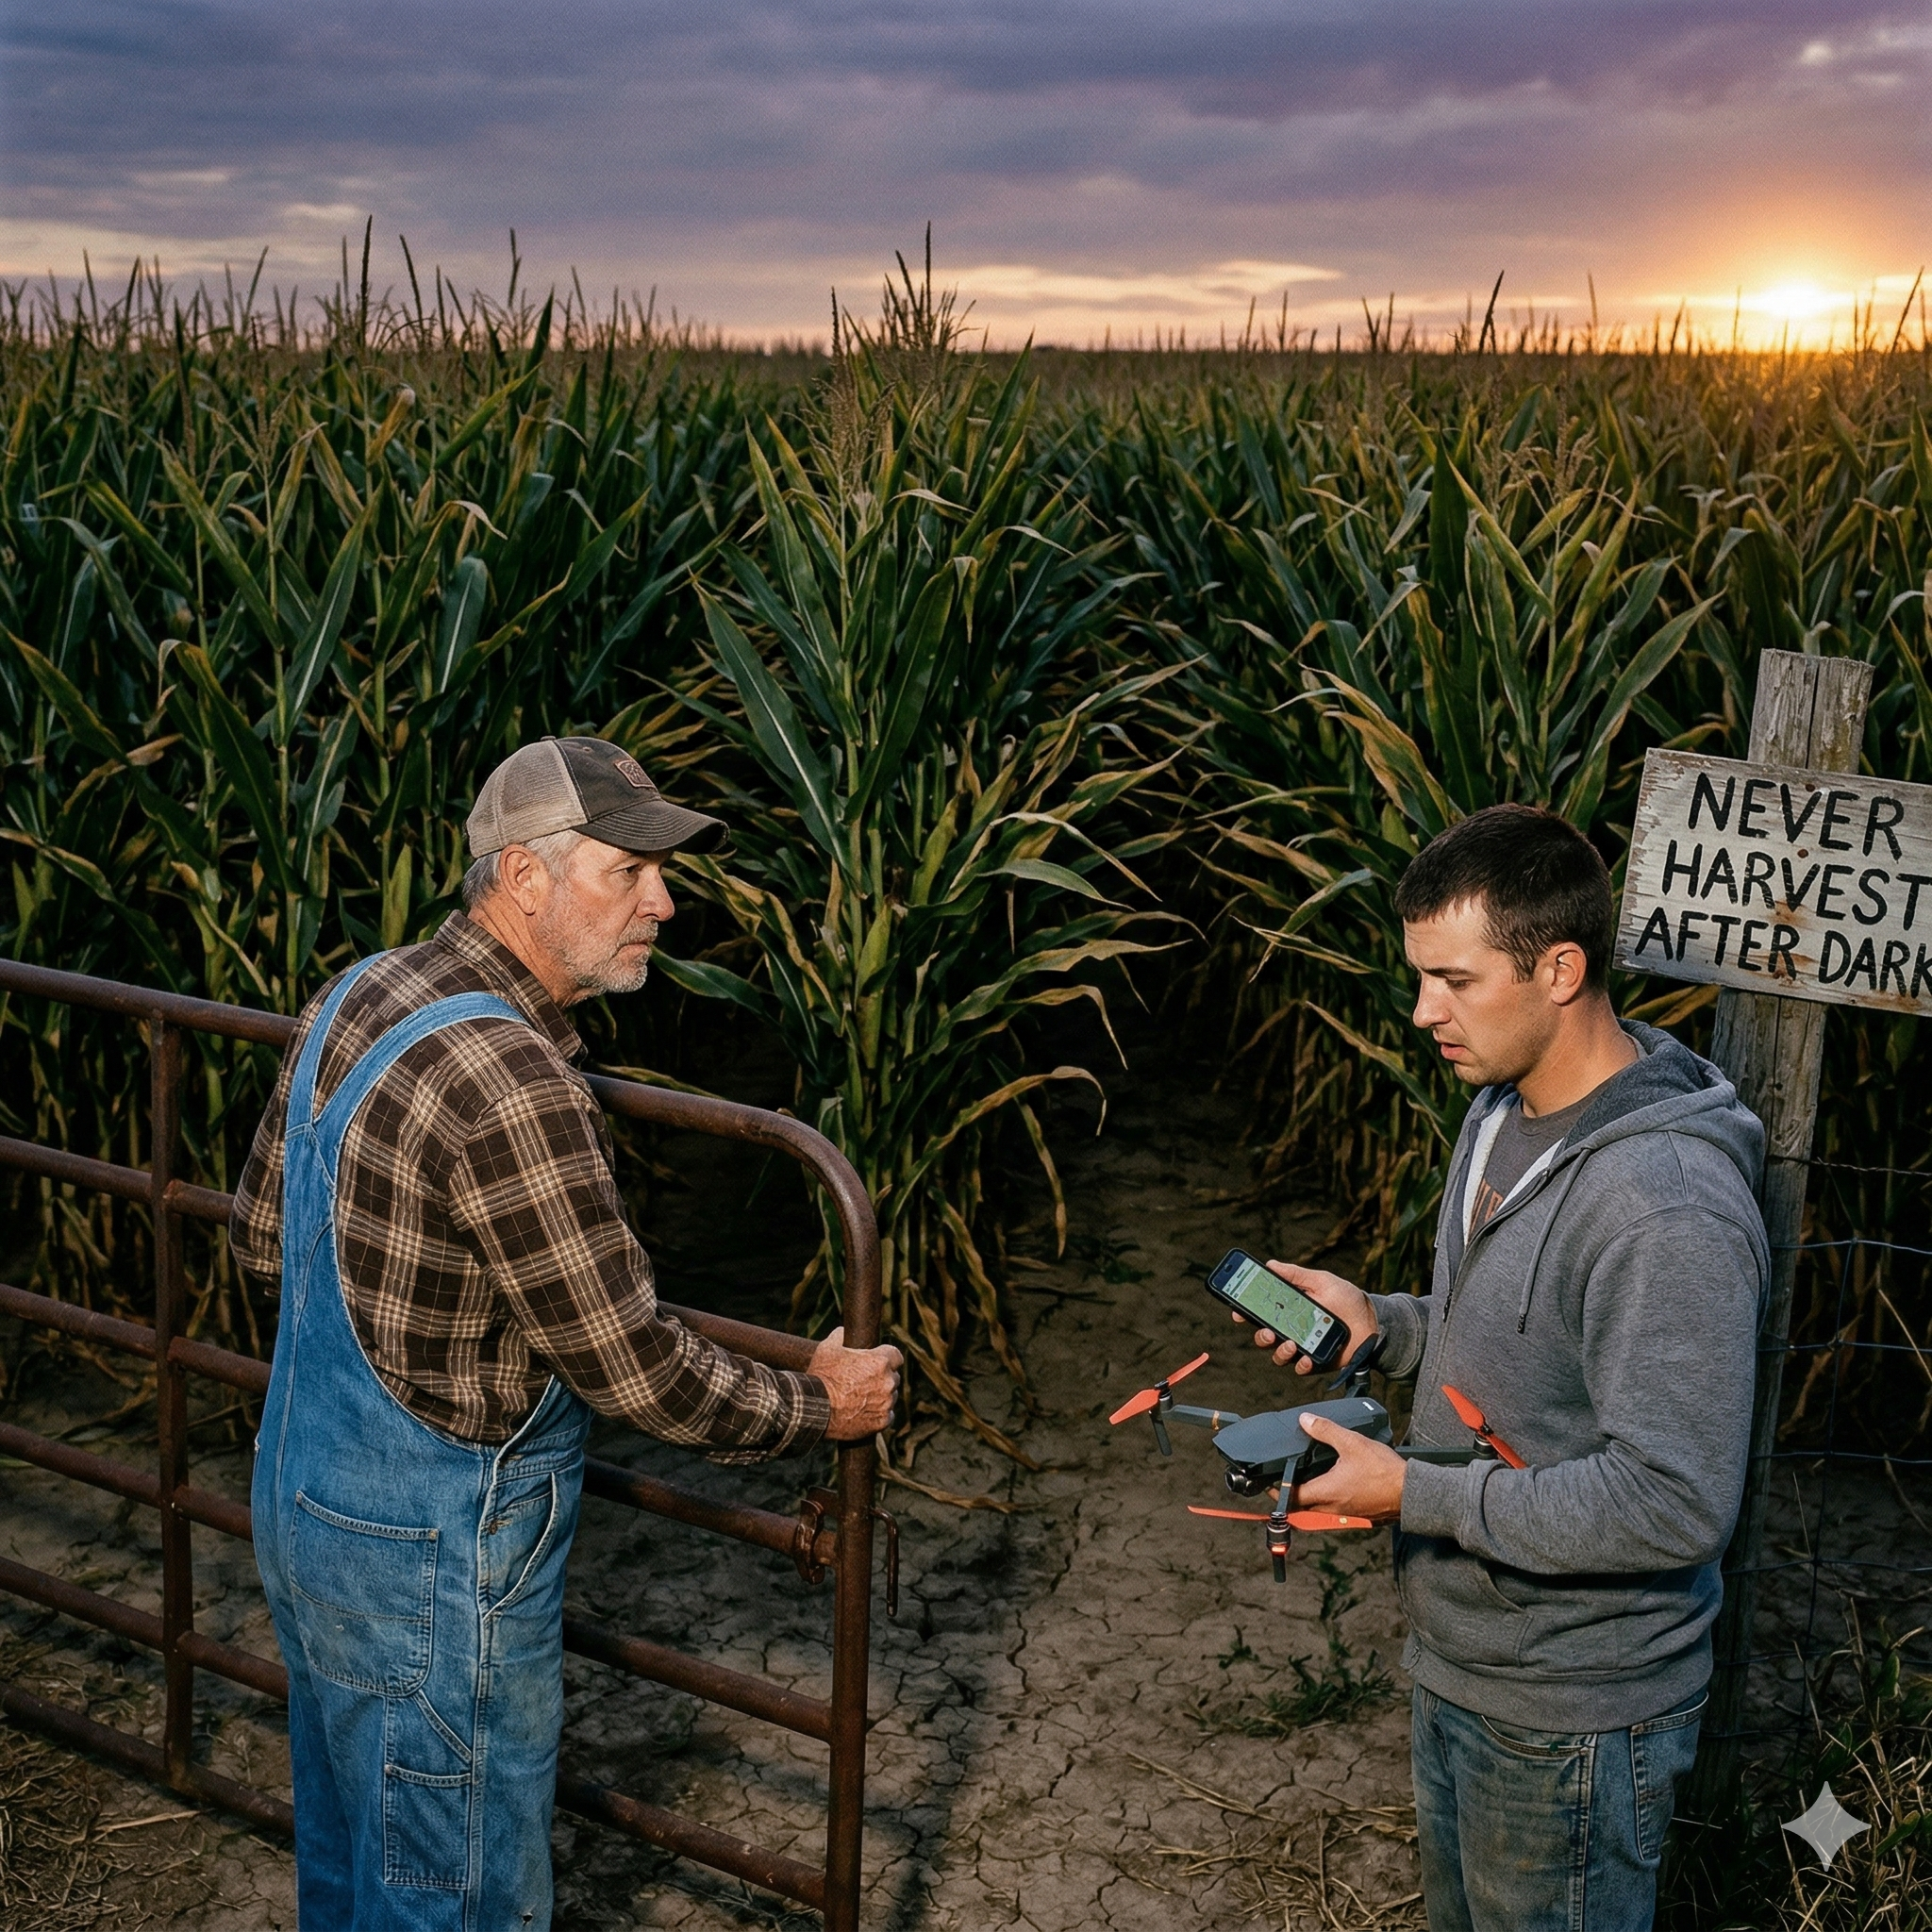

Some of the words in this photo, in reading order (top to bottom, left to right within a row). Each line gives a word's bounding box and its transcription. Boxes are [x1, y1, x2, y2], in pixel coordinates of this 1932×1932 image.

[1688, 772, 1905, 860] NEVER
[1661, 840, 1932, 931] HARVEST
[1634, 907, 1800, 980] AFTER
[1818, 930, 1932, 999] DARK
